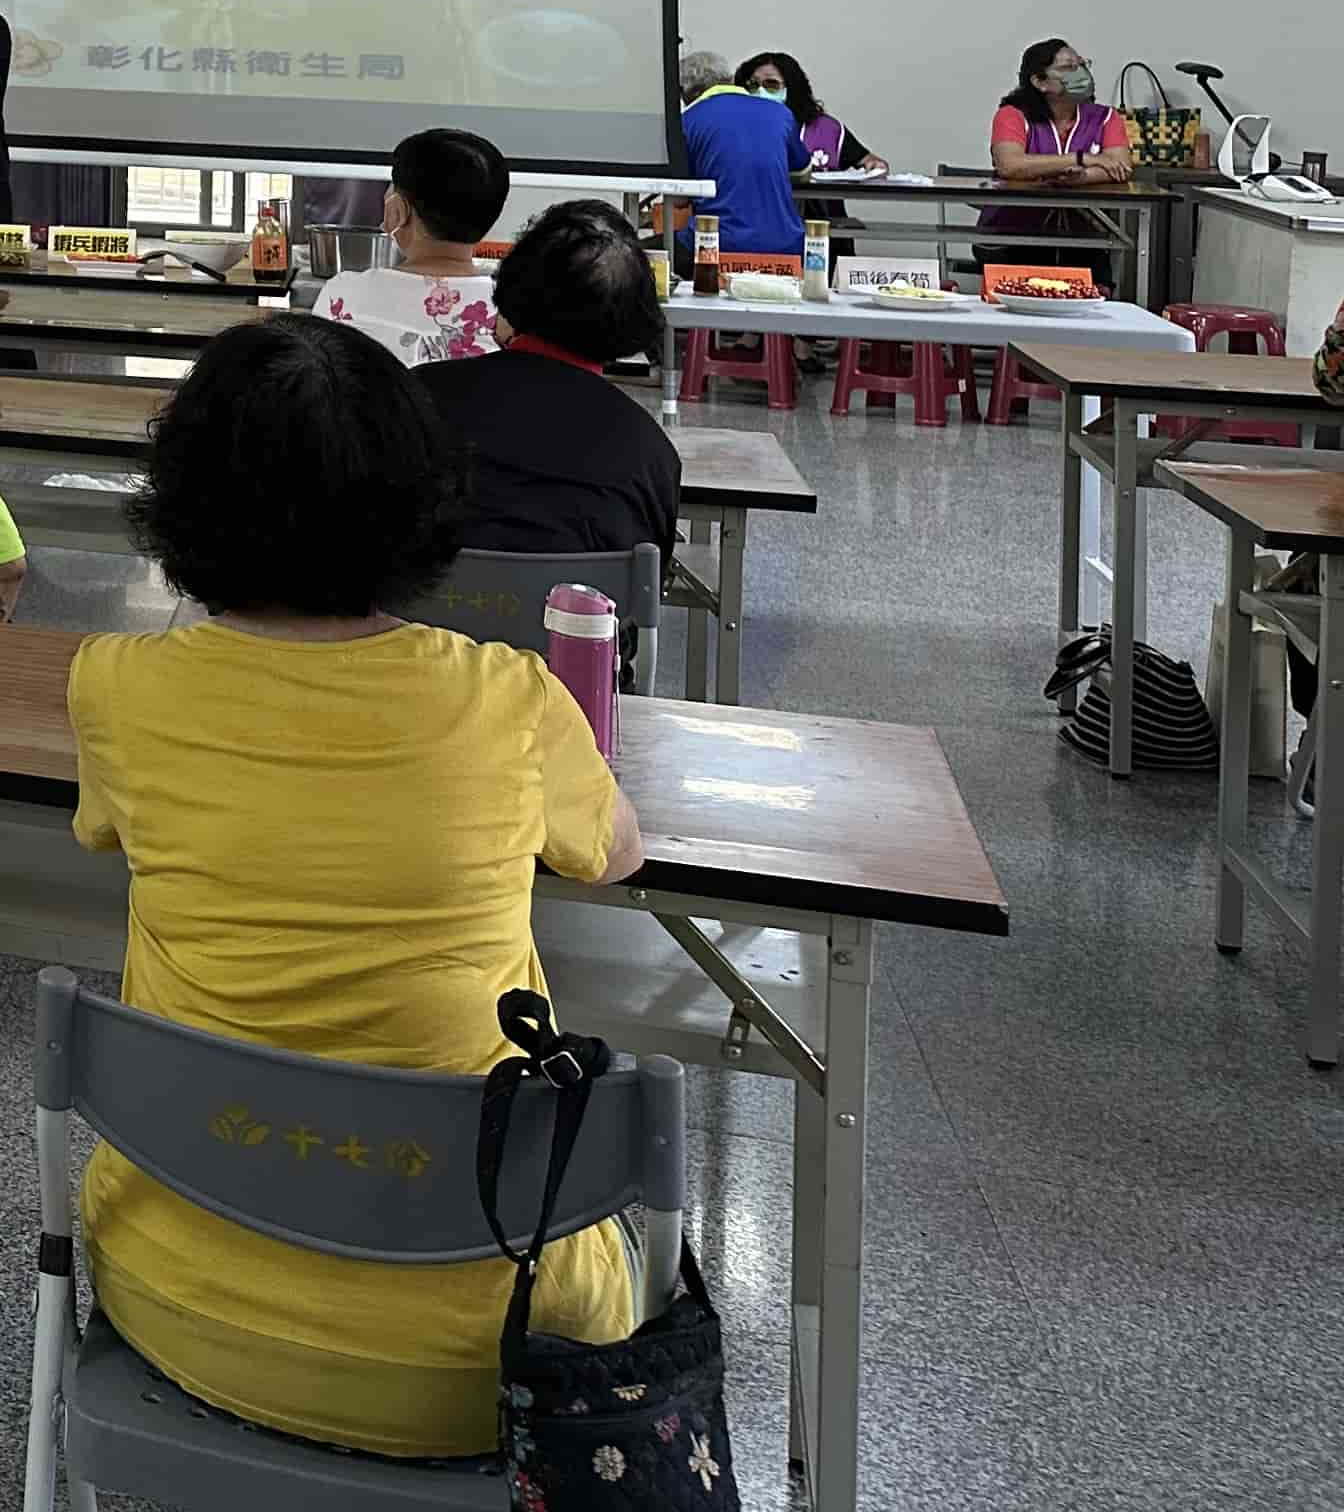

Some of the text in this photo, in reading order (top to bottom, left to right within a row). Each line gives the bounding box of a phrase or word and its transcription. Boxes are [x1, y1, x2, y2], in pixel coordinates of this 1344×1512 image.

[86, 44, 407, 82] 彰化縣衛生局
